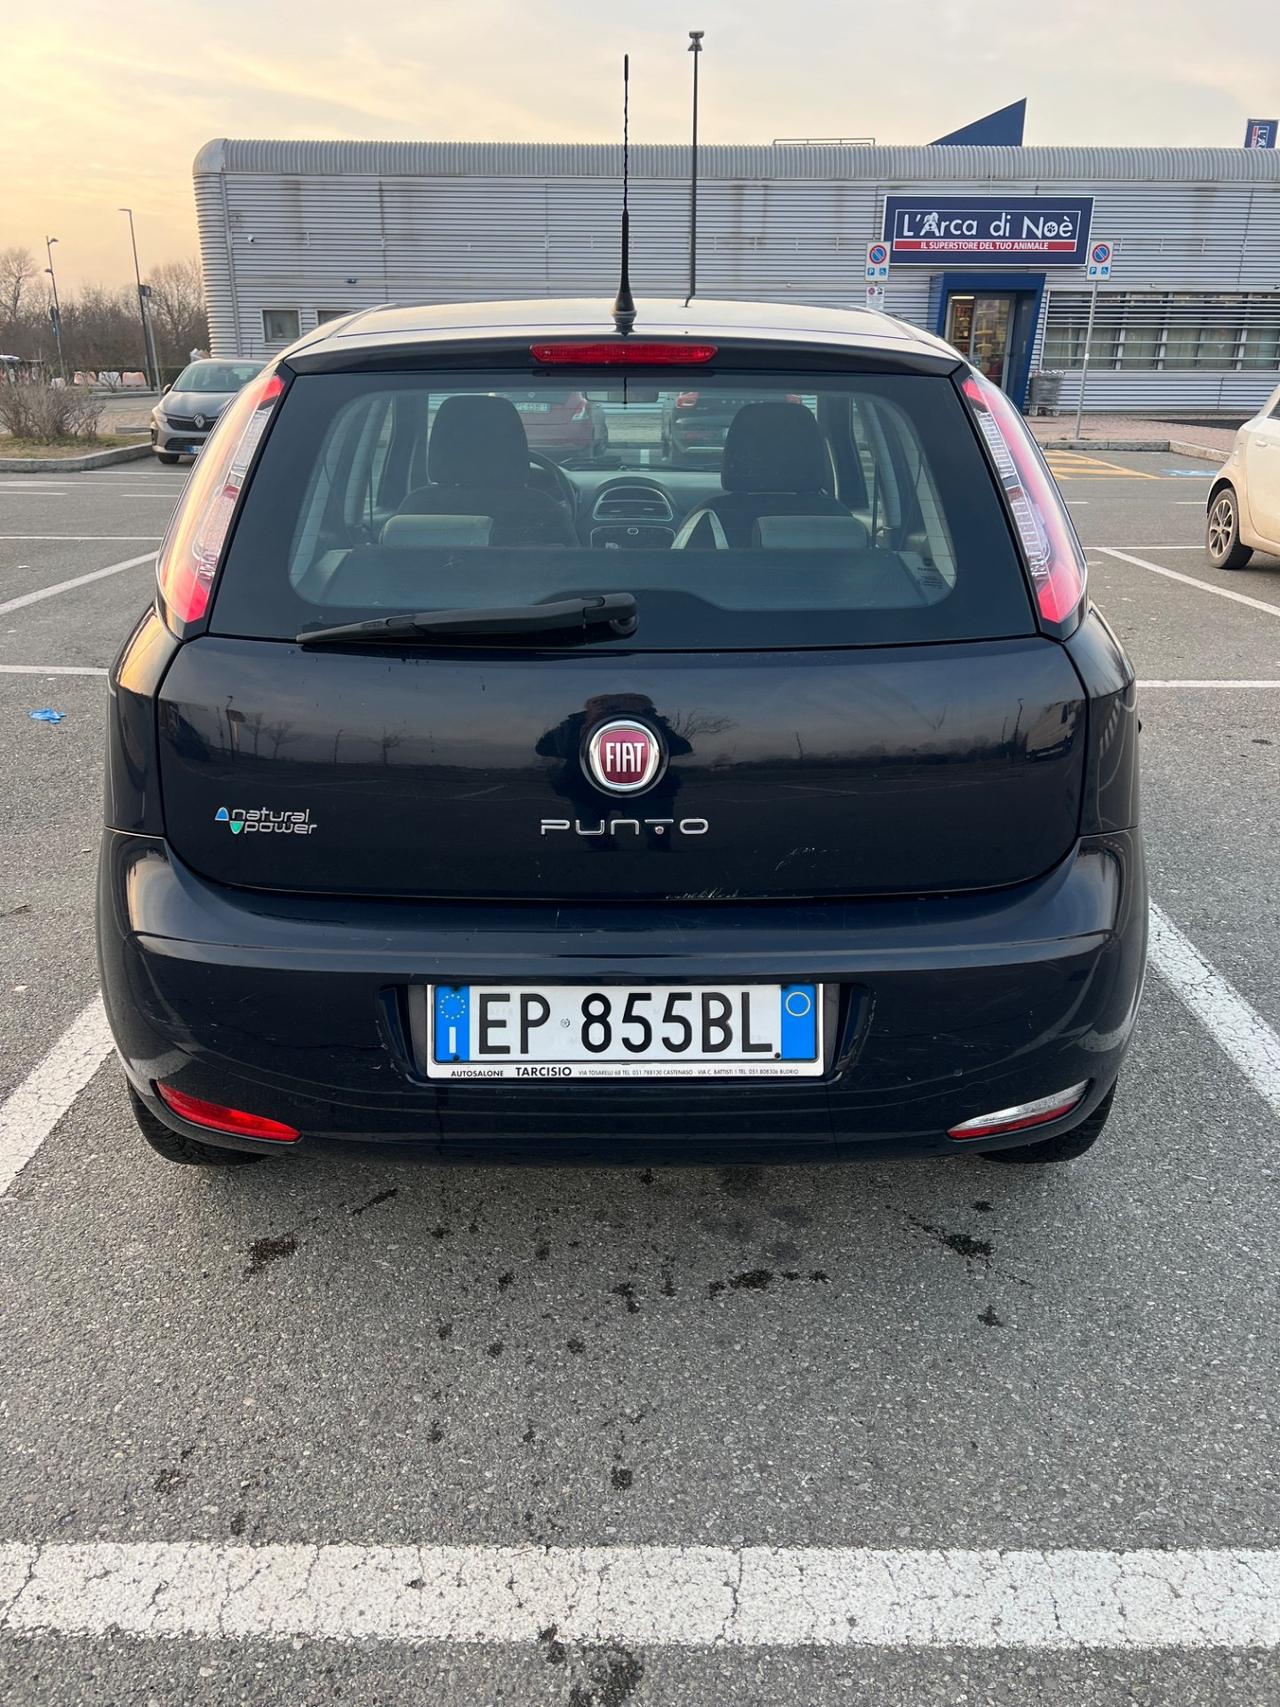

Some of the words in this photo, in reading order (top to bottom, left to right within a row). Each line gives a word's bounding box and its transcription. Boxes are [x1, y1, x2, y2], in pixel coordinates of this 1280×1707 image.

[903, 212, 977, 237] L'Arca
[990, 212, 1011, 237] di
[1022, 216, 1073, 239] Noè
[920, 241, 928, 249] IL
[929, 241, 978, 249] SUPERSTORE
[980, 241, 994, 249] DEL
[995, 242, 1012, 250] TUO
[1013, 242, 1049, 250] ANIMALE
[605, 742, 646, 772] FIAT
[232, 806, 310, 822] natural
[244, 821, 318, 834] power
[541, 818, 709, 836] PUNTO
[479, 993, 551, 1054] EP
[581, 992, 773, 1053] 855BL
[515, 1066, 572, 1077] TARCISIO
